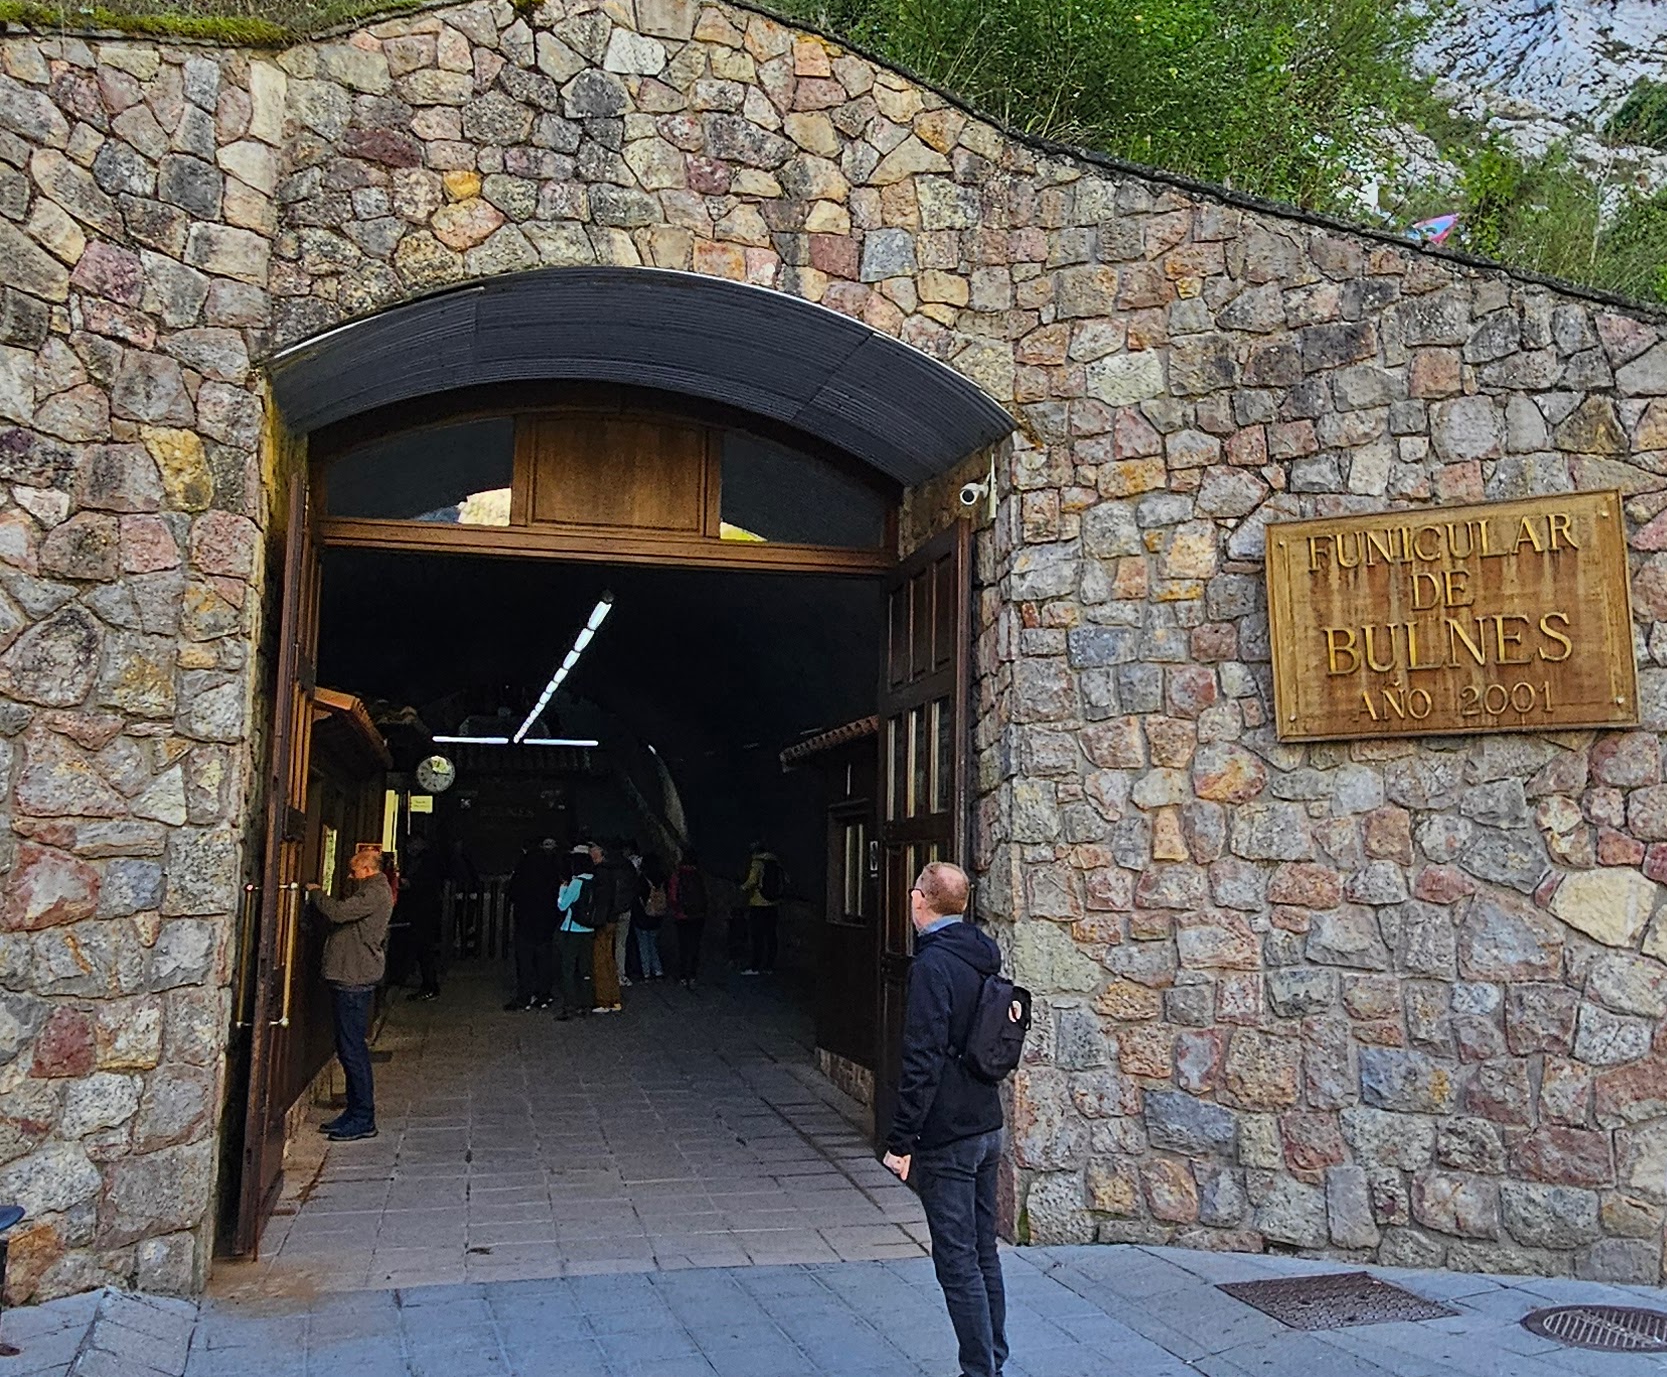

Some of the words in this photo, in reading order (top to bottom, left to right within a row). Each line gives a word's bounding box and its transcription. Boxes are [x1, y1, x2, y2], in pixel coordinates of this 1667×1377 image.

[1307, 512, 1579, 572] FUNICULAR
[1411, 569, 1475, 611] DE
[1324, 612, 1574, 676] BULNES
[1354, 679, 1434, 722] AÑO
[1460, 679, 1555, 716] 2001
